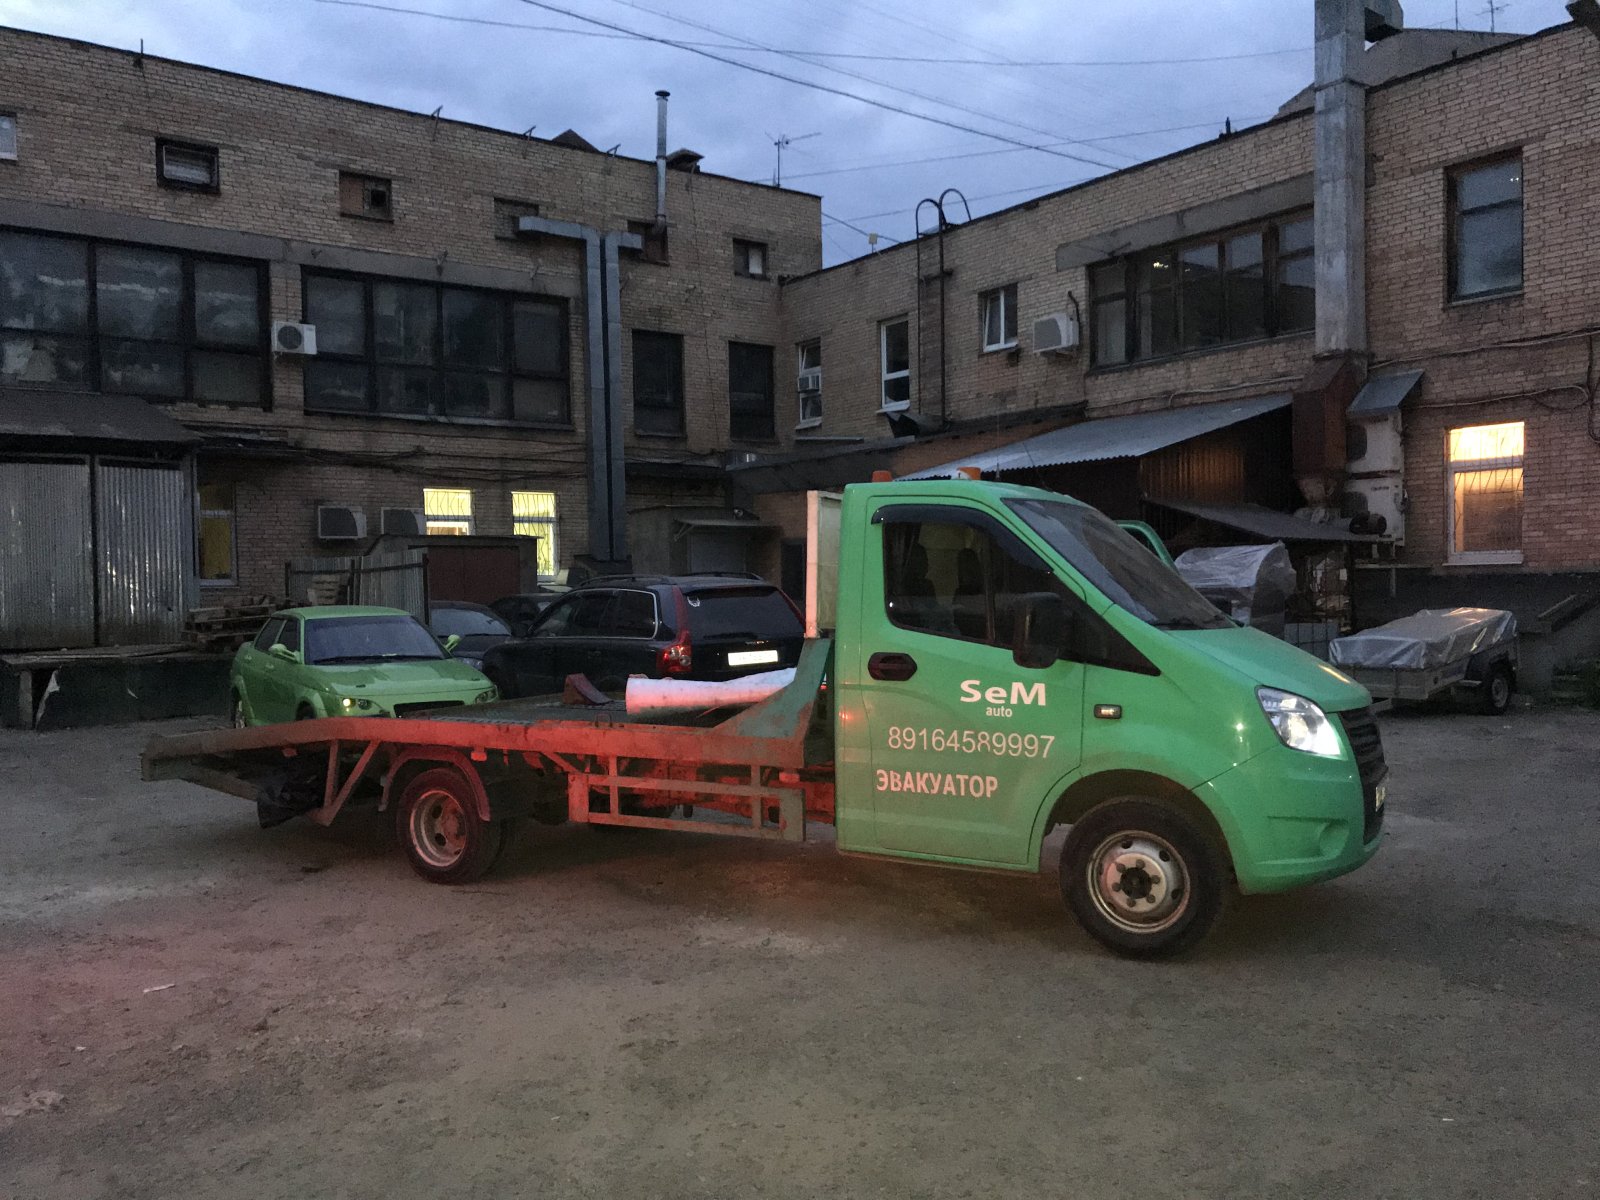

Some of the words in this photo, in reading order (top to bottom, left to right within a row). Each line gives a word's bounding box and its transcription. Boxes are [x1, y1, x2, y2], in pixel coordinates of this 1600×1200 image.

[960, 679, 1046, 706] SeM
[985, 705, 1013, 718] auto
[888, 726, 1055, 758] 89164589997
[876, 769, 998, 798] ЭВАКУАТОР
